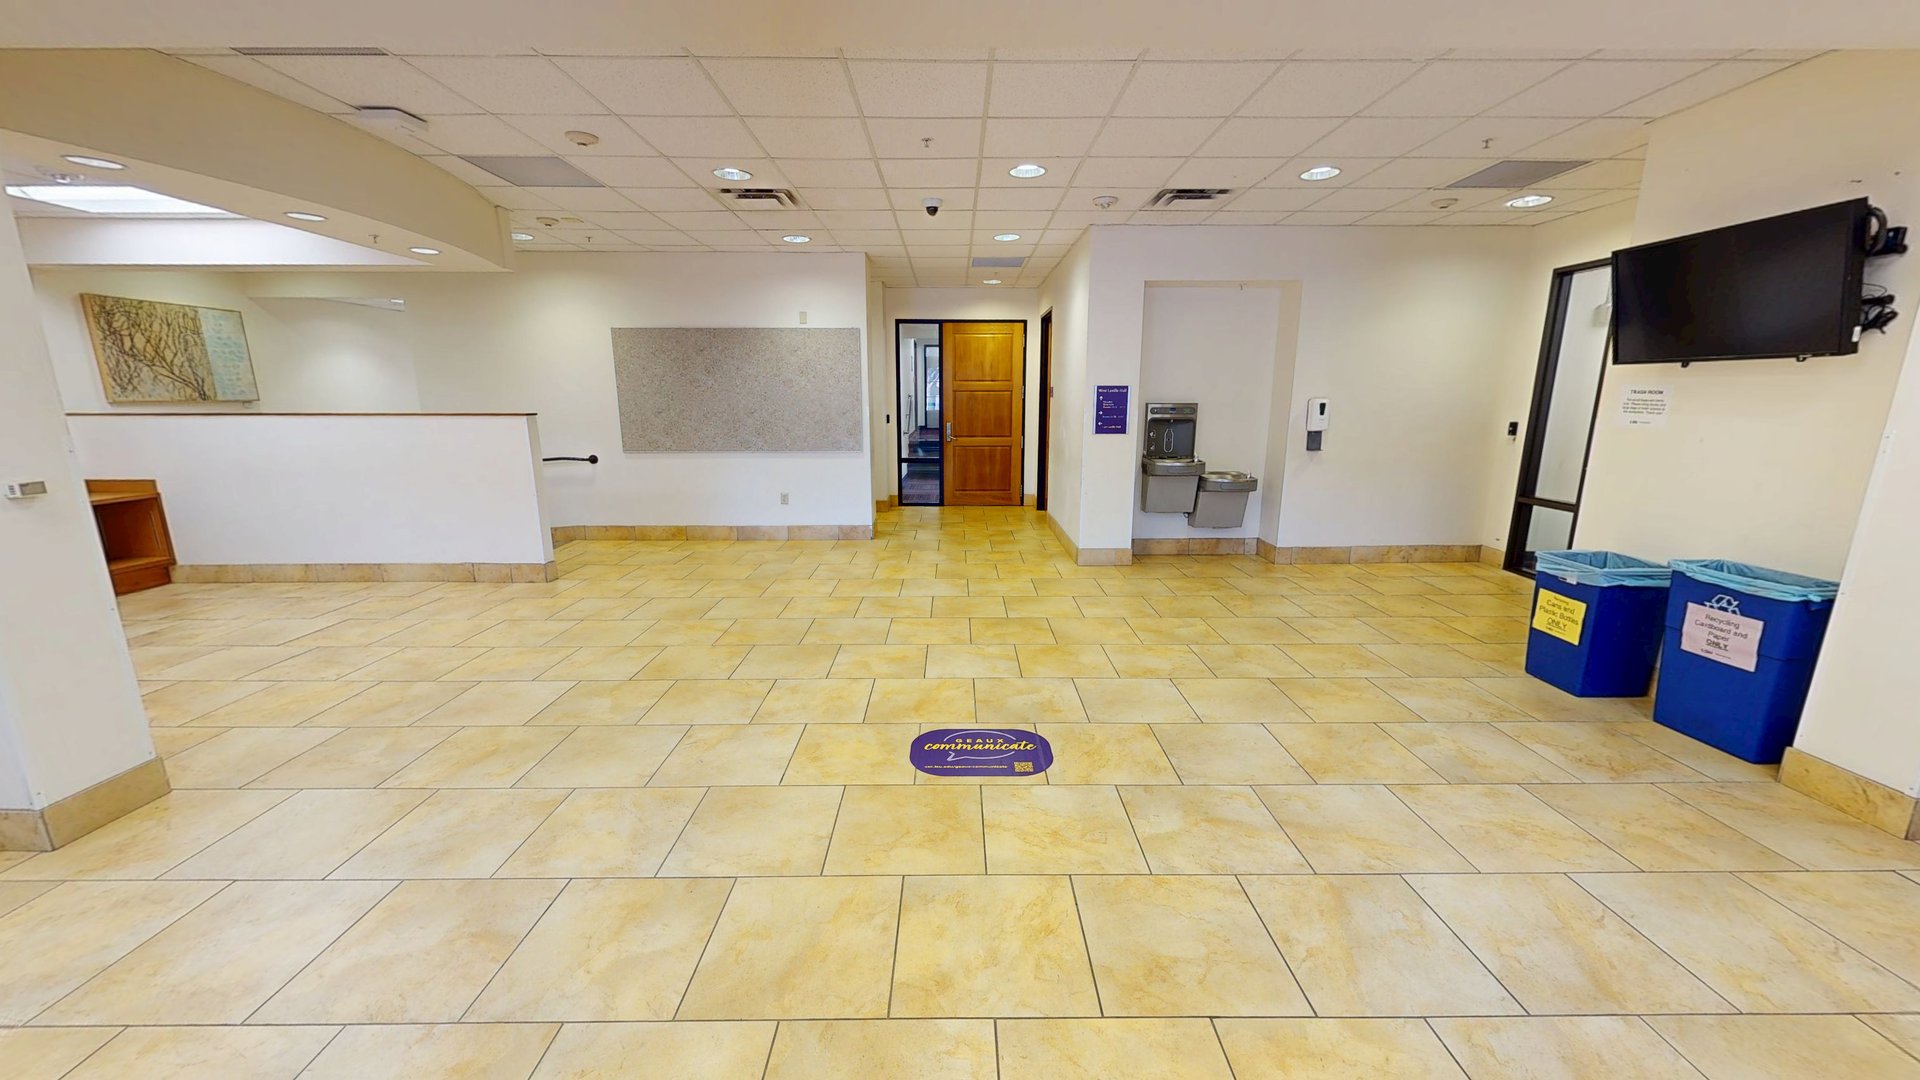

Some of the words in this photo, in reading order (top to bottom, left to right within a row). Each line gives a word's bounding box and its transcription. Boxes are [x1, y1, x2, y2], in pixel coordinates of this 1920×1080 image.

[1546, 616, 1568, 630] ONLY
[1704, 613, 1740, 630] Recycling
[1694, 619, 1732, 635] Cardboard
[1732, 629, 1749, 640] and
[1707, 630, 1730, 642] Paper
[1705, 638, 1729, 651] ONLY
[924, 740, 1037, 751] communicate
